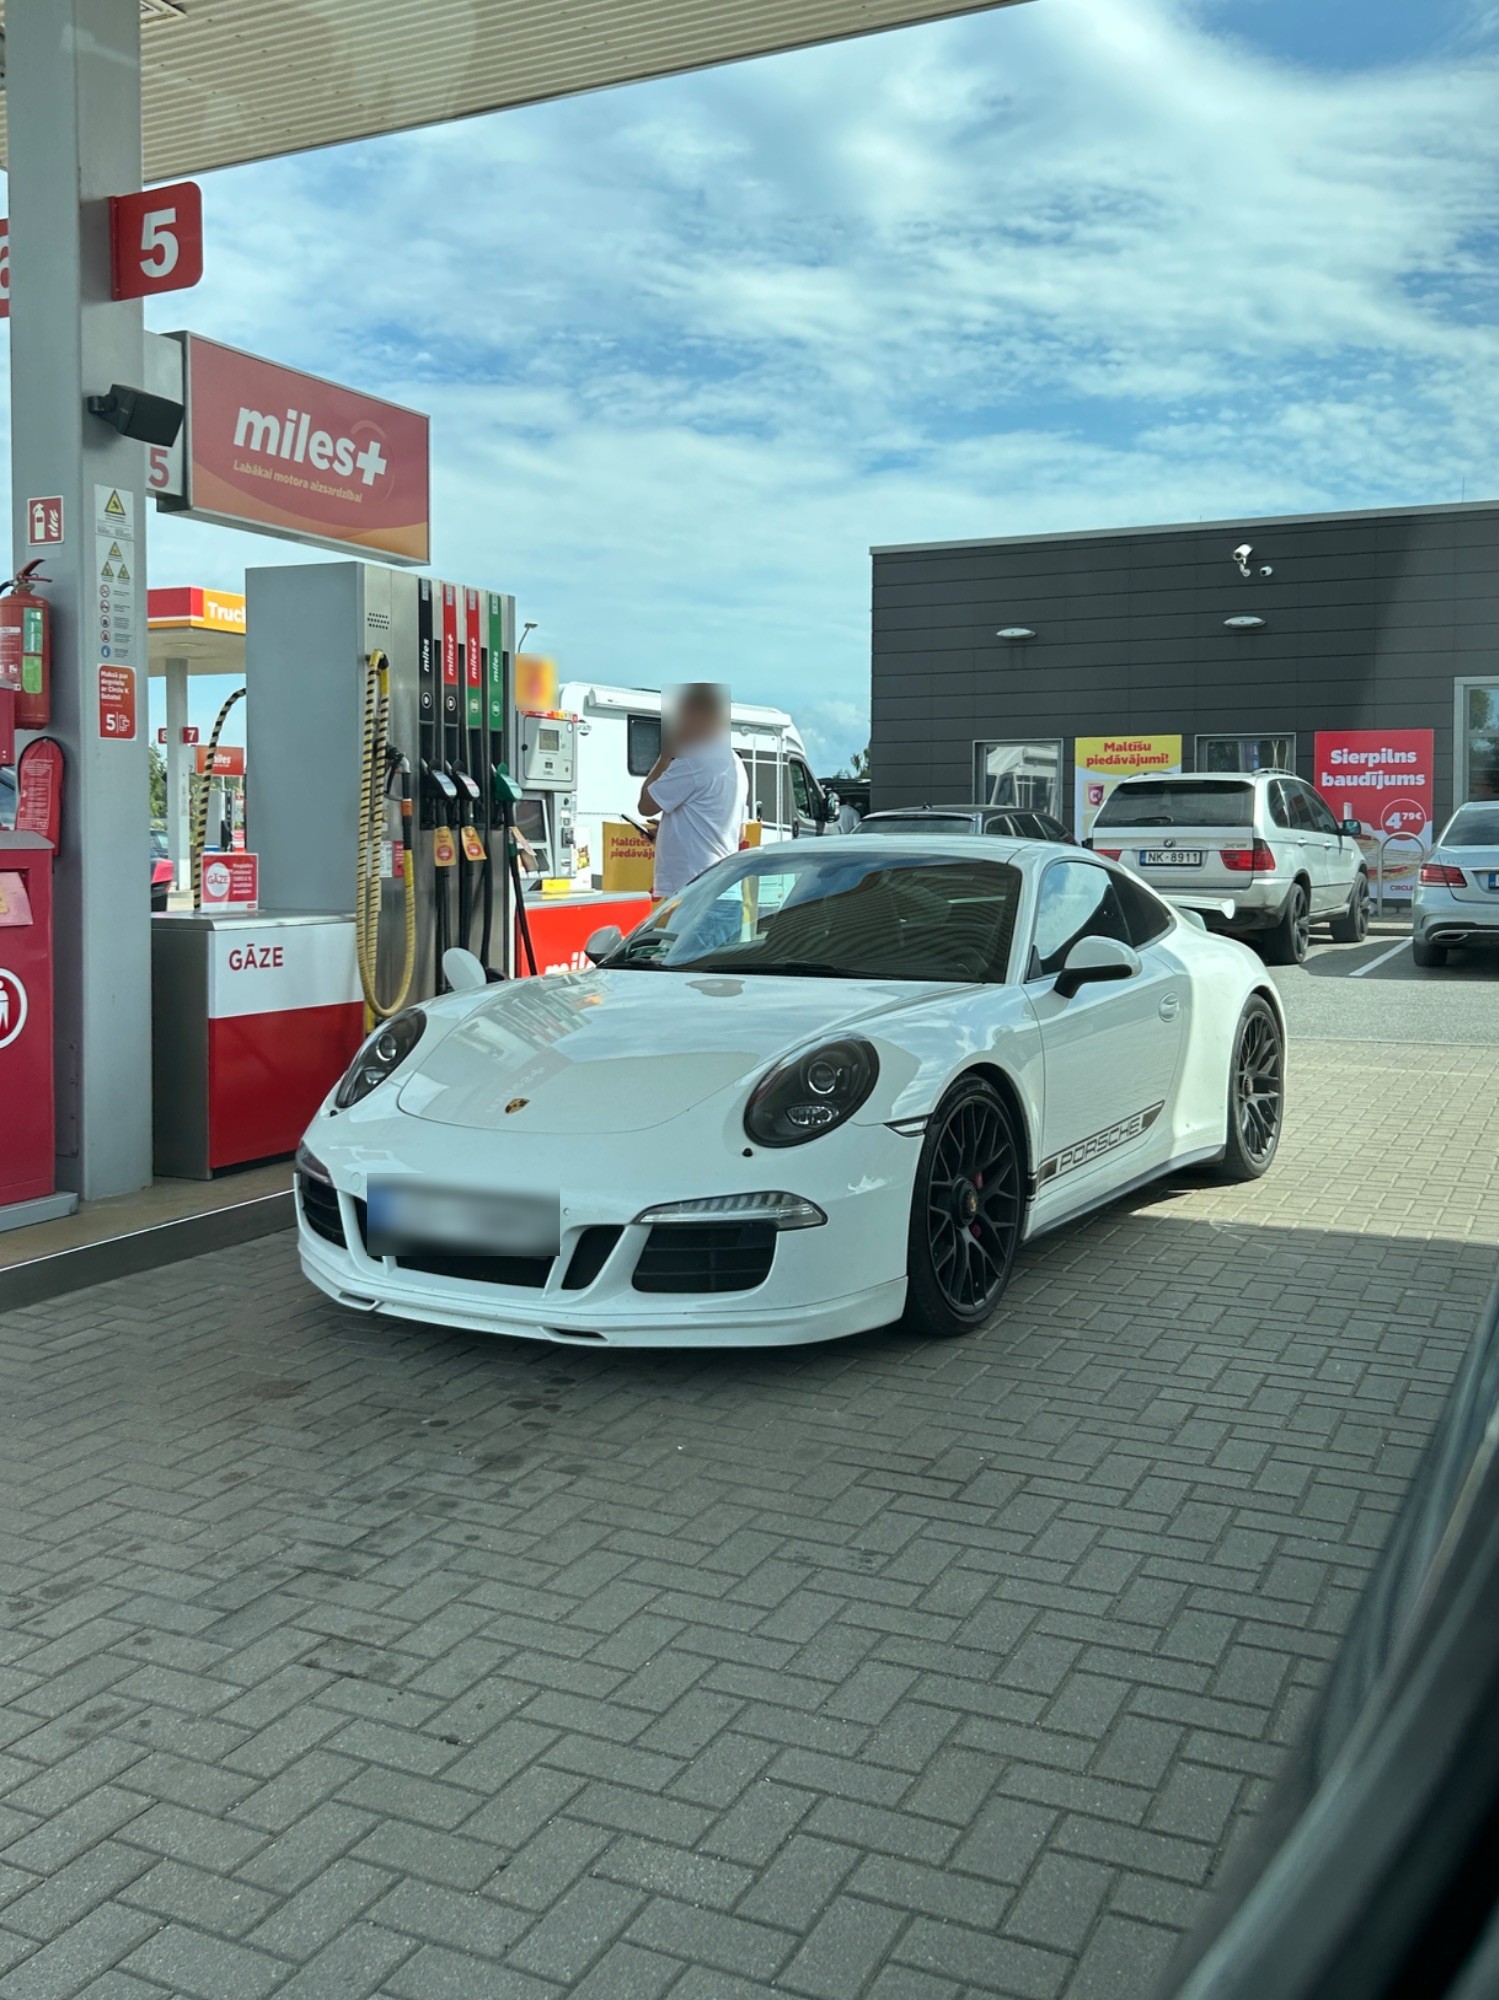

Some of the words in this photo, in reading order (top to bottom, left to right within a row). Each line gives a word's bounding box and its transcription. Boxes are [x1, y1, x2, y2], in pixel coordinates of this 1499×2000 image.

[139, 207, 179, 278] 5
[233, 406, 388, 487] miles+
[149, 447, 169, 488] 5
[273, 471, 309, 489] motora
[422, 638, 430, 672] miles
[492, 650, 500, 683] miles
[105, 713, 116, 731] 5
[187, 729, 195, 740] 7
[1103, 740, 1152, 752] Maltīšu
[1086, 752, 1169, 767] piedāvājumi!
[1330, 747, 1417, 767] Sierpilns
[1321, 769, 1426, 790] baudījums
[1147, 851, 1199, 863] NK-8911
[207, 873, 229, 884] GĀZE
[228, 943, 284, 971] GĀZE
[1059, 1116, 1141, 1172] PORSCHE
